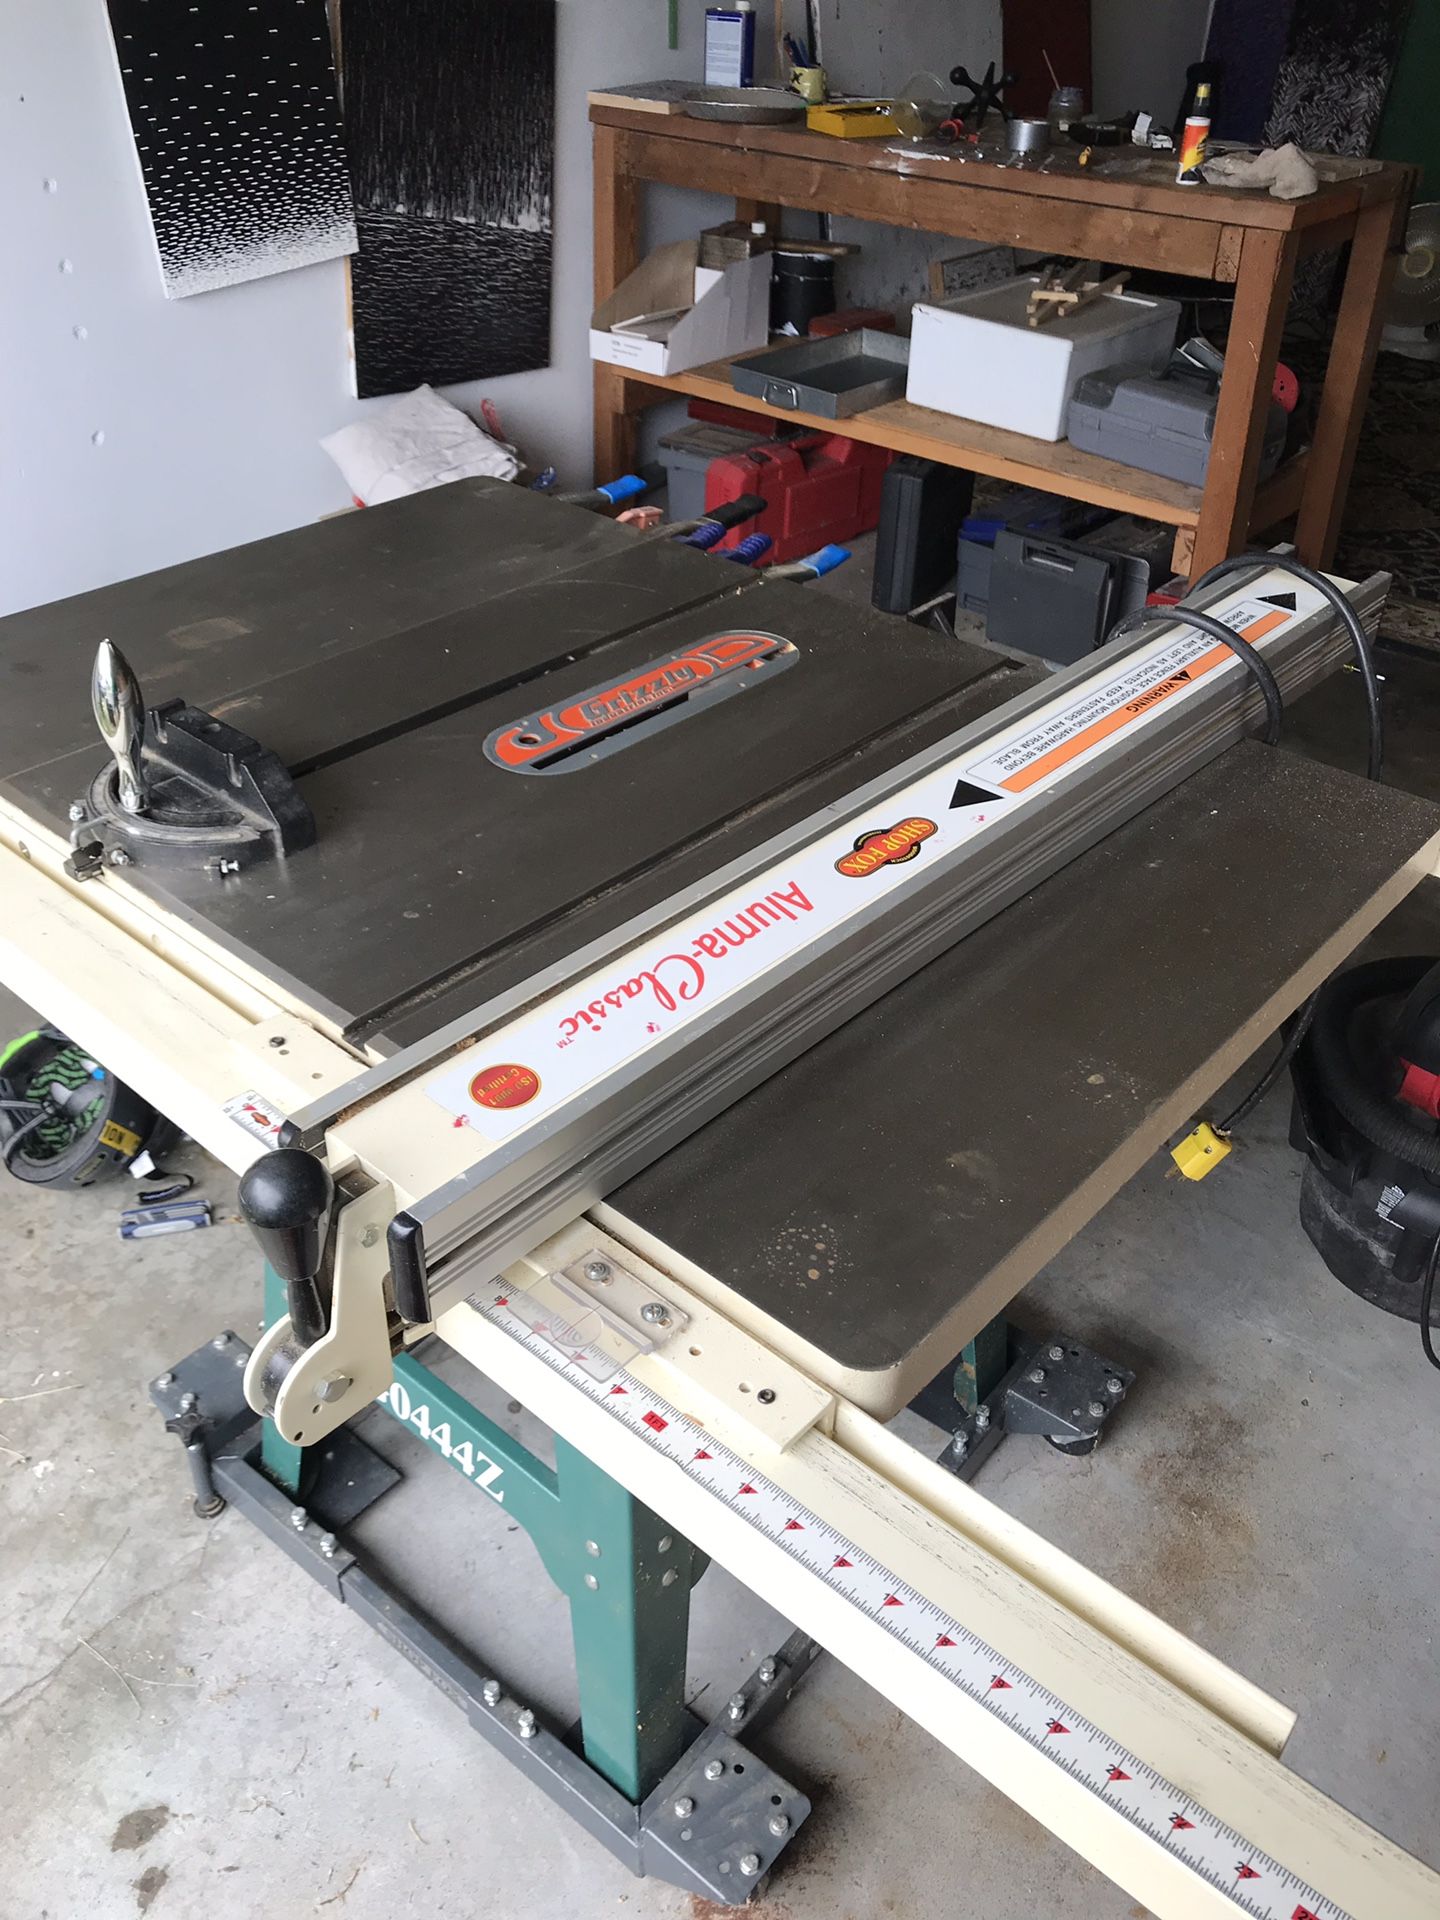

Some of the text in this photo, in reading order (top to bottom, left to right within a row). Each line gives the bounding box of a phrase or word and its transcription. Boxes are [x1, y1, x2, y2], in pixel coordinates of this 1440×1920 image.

[1153, 664, 1176, 677] FENCE
[579, 665, 698, 720] Grizzly
[1106, 686, 1122, 696] KEEP
[1107, 688, 1138, 706] POSITION
[1126, 681, 1178, 713] WARNING
[1064, 698, 1105, 720] FASTENERS
[1044, 721, 1064, 735] AWAY
[1021, 735, 1044, 748] FROM
[1034, 727, 1072, 752] HARDWARE
[1004, 751, 1036, 770] BEYOND
[882, 820, 930, 851] SHOP
[843, 847, 888, 873] FOX
[648, 1415, 667, 1430] 1FT
[785, 1517, 798, 1529] 15
[833, 1555, 847, 1567] 16
[935, 1632, 950, 1646] 18
[990, 1674, 1005, 1688] 19
[1045, 1717, 1063, 1733] 20
[1105, 1763, 1123, 1780] 21
[1168, 1812, 1187, 1828] 22
[1234, 1861, 1254, 1879] 23
